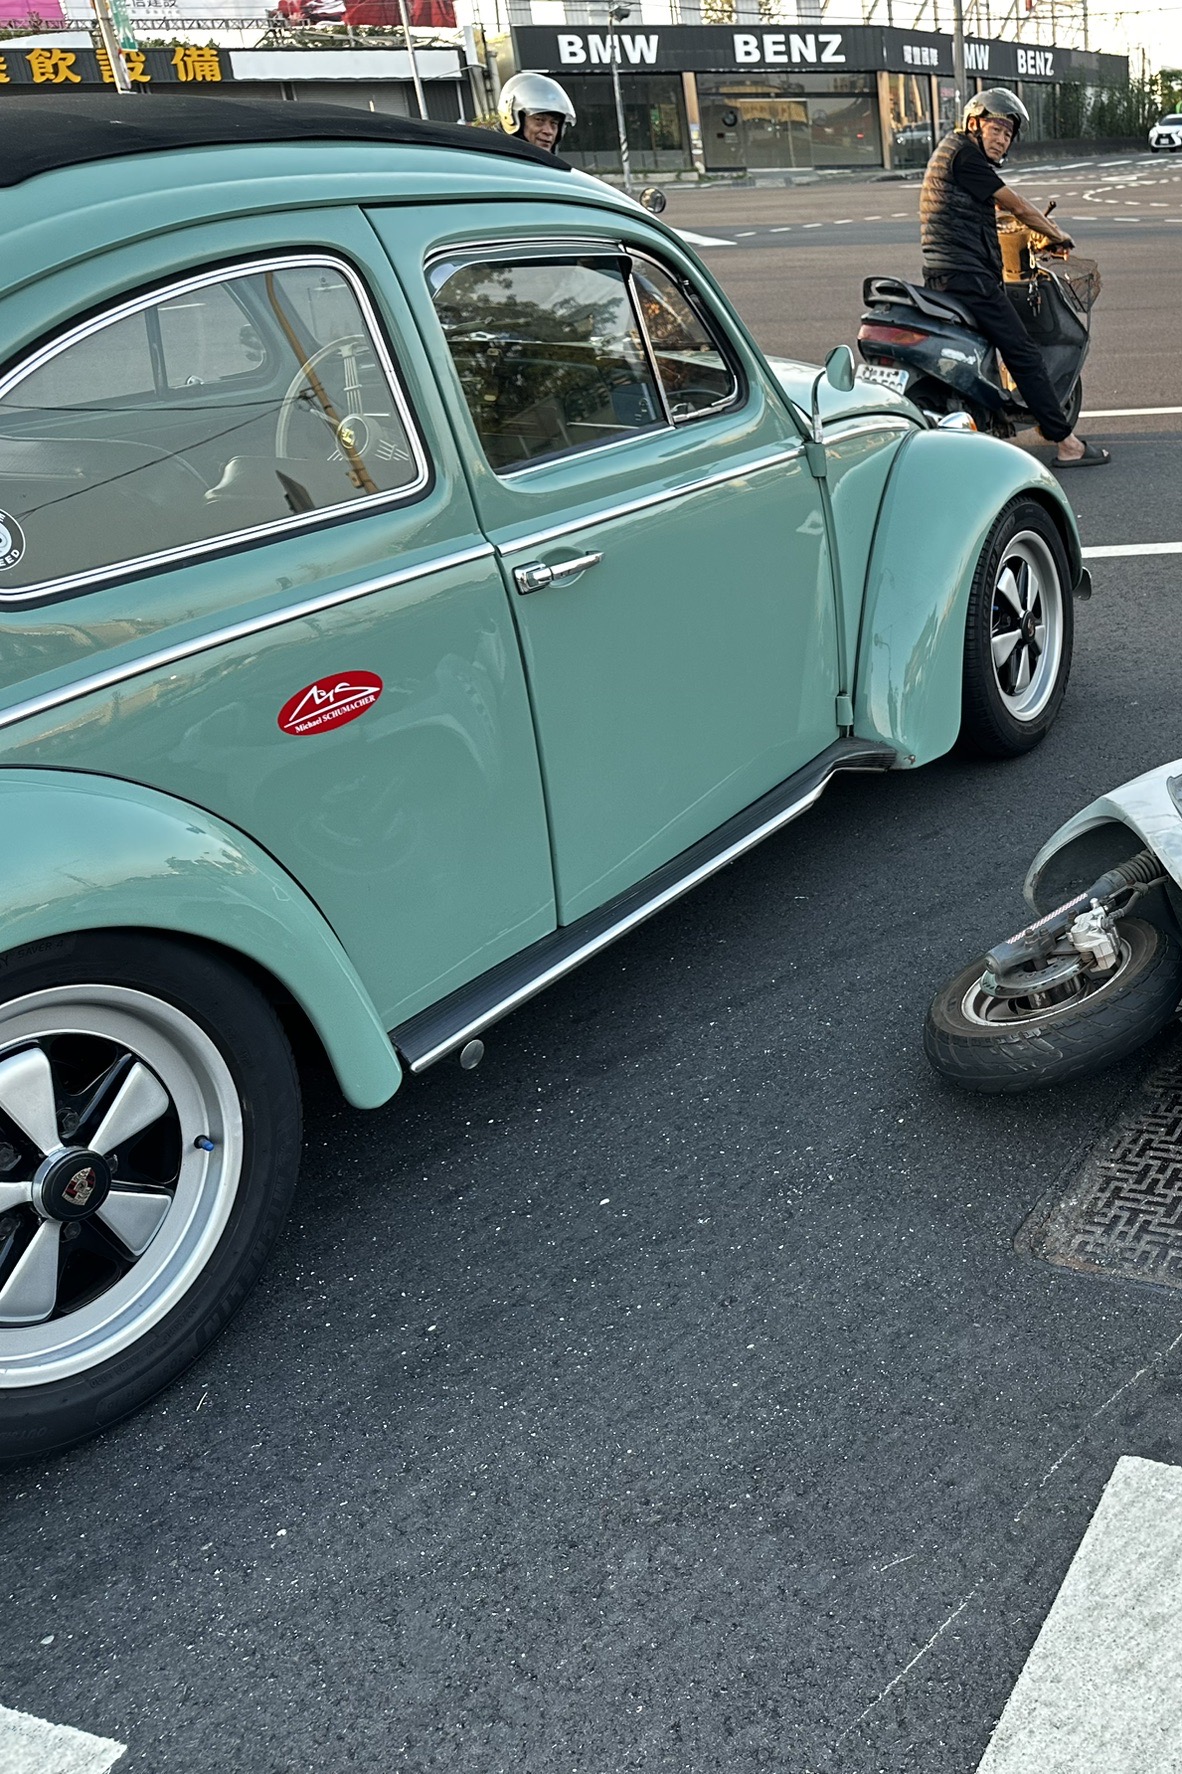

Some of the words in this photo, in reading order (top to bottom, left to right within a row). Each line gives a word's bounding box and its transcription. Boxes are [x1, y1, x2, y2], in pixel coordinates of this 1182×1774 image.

[557, 34, 659, 64] BMW
[733, 34, 846, 63] BENZ
[952, 42, 989, 71] MW
[1017, 48, 1055, 76] BENZ
[0, 48, 222, 83] 飲設備
[295, 717, 322, 733] Michael
[322, 695, 375, 722] SCHUMACHER
